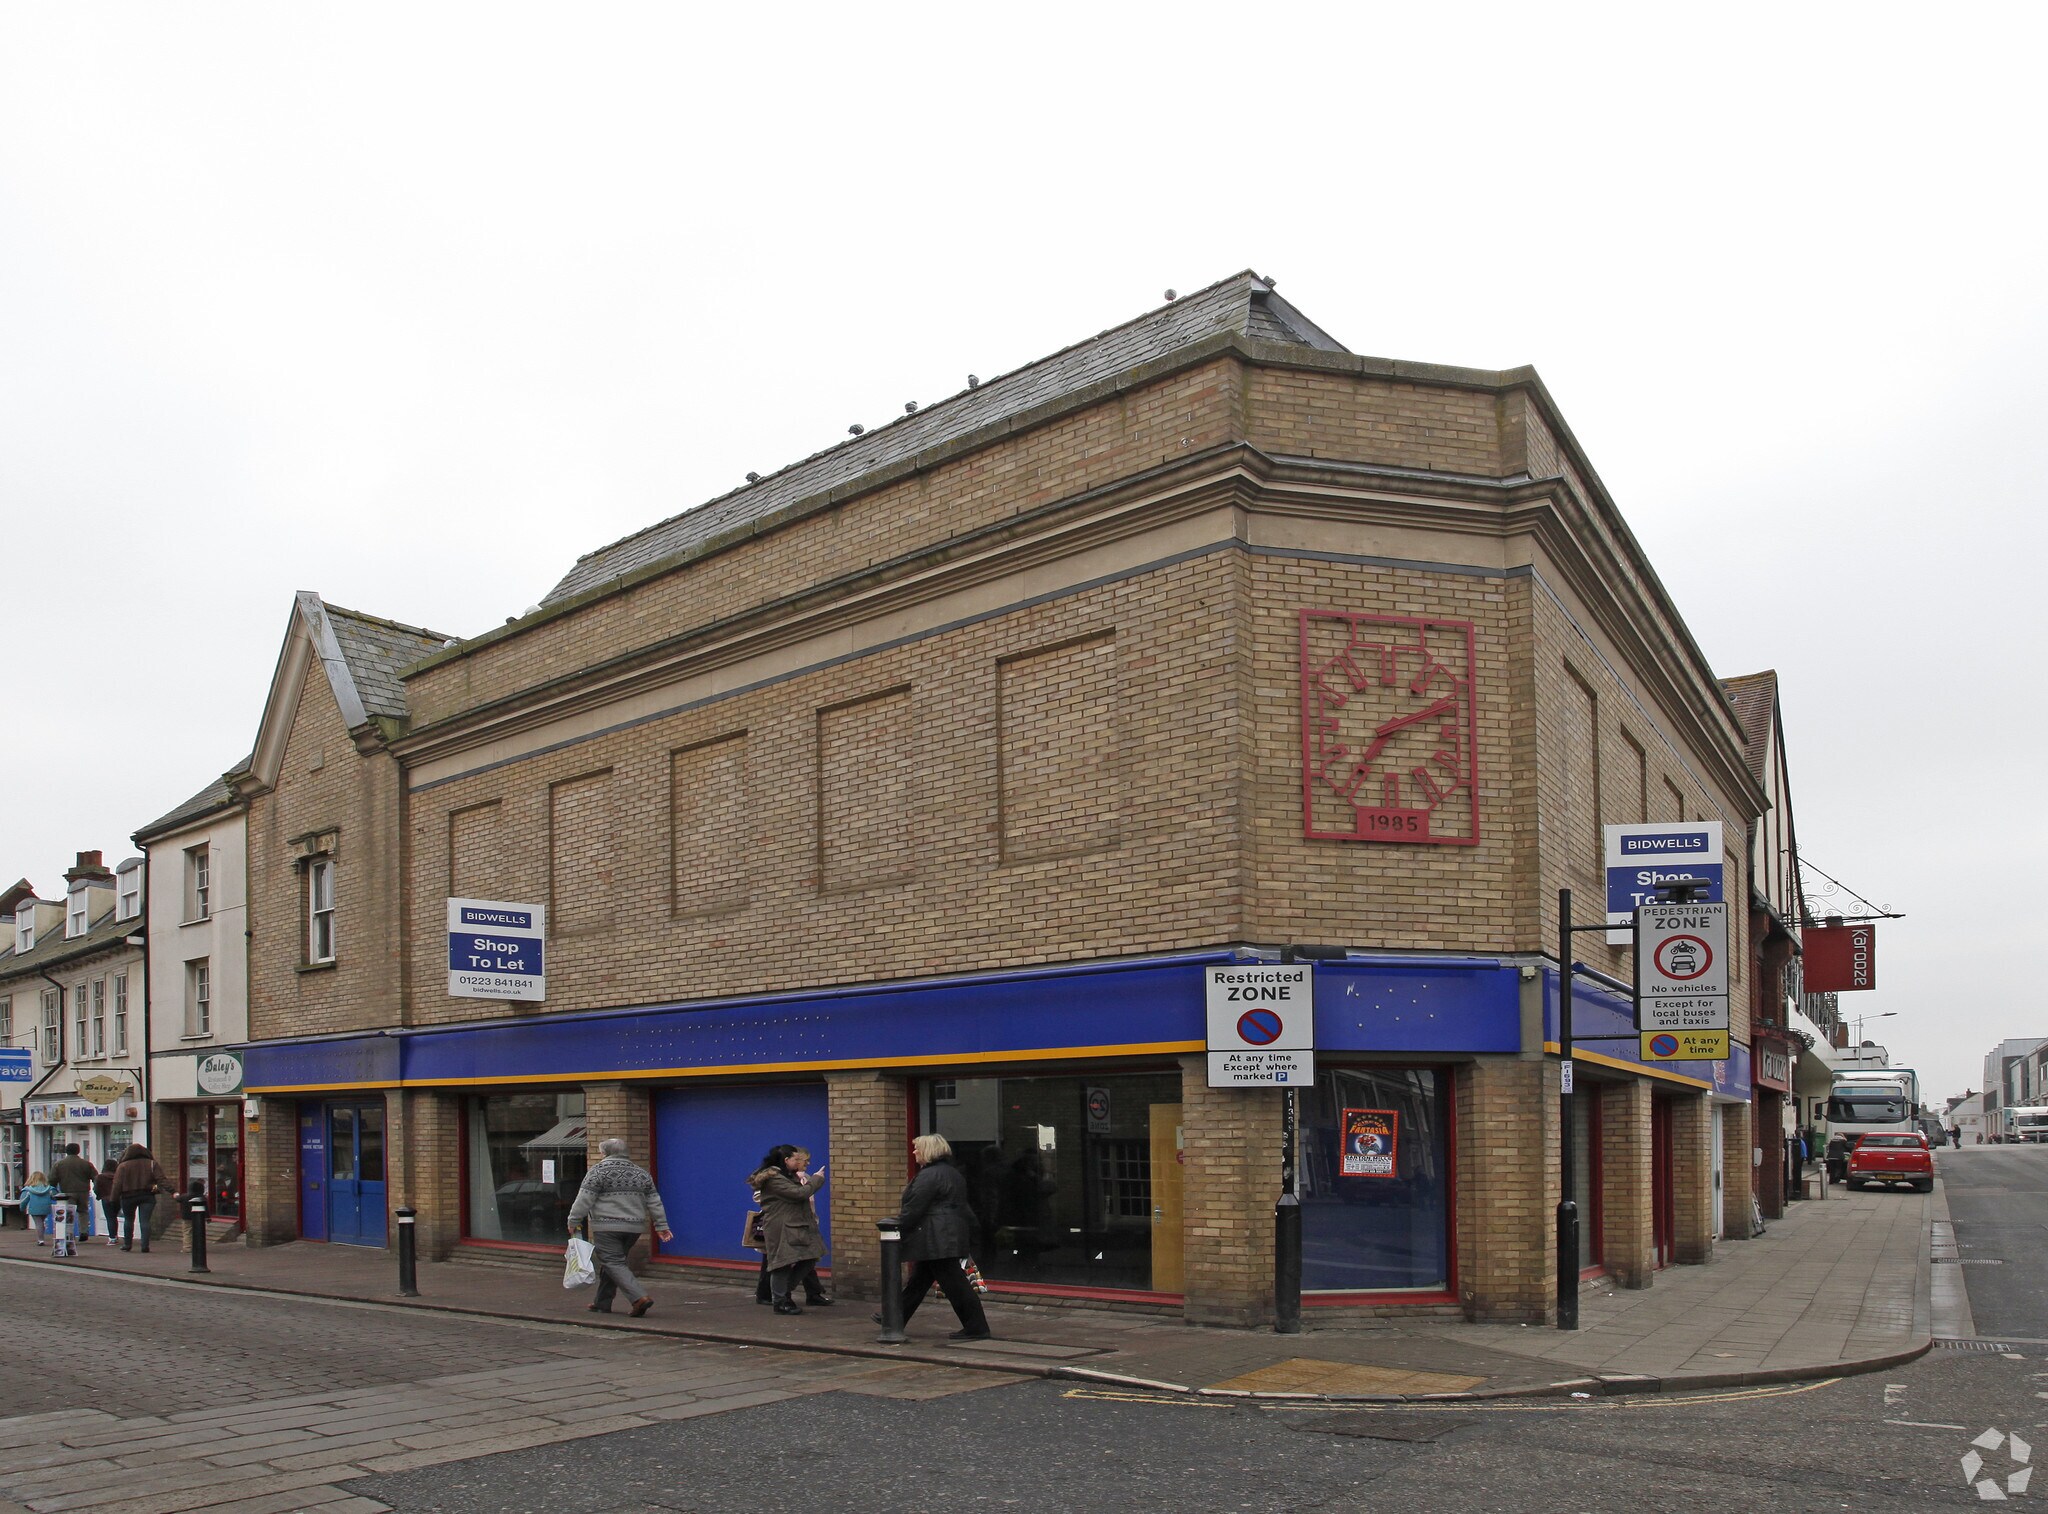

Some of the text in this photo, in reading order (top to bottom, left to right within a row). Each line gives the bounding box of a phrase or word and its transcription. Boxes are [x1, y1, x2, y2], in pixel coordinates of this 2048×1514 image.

[1368, 813, 1418, 833] 1985
[1628, 838, 1701, 850] BIDWELLS
[1644, 907, 1722, 916] PEDESTRIAN
[467, 912, 526, 924] BIDWELLS
[1655, 917, 1711, 929] ZONE
[474, 938, 519, 955] Shop
[1851, 929, 1869, 986] Karooze
[469, 955, 525, 971] To Let
[460, 975, 533, 988] 01223 841841
[1214, 971, 1304, 984] Restricted
[473, 987, 521, 995] bidwells.co.uk
[1227, 986, 1291, 1001] ZONE
[1671, 984, 1717, 993] vehicles
[1655, 1000, 1694, 1009] Except
[1652, 1009, 1716, 1018] local buses
[1683, 1017, 1710, 1025] taxis
[1683, 1037, 1720, 1046] At any
[1689, 1046, 1714, 1054] time
[1245, 1055, 1264, 1063] any
[1269, 1053, 1292, 1061] time
[205, 1058, 235, 1074] Daley's
[1223, 1063, 1298, 1072] Except where
[1233, 1072, 1286, 1081] marked P
[85, 1083, 118, 1092] Daley's
[81, 1108, 95, 1117] Olsen
[95, 1106, 109, 1117] Travel
[1349, 1125, 1389, 1135] FANTASIA
